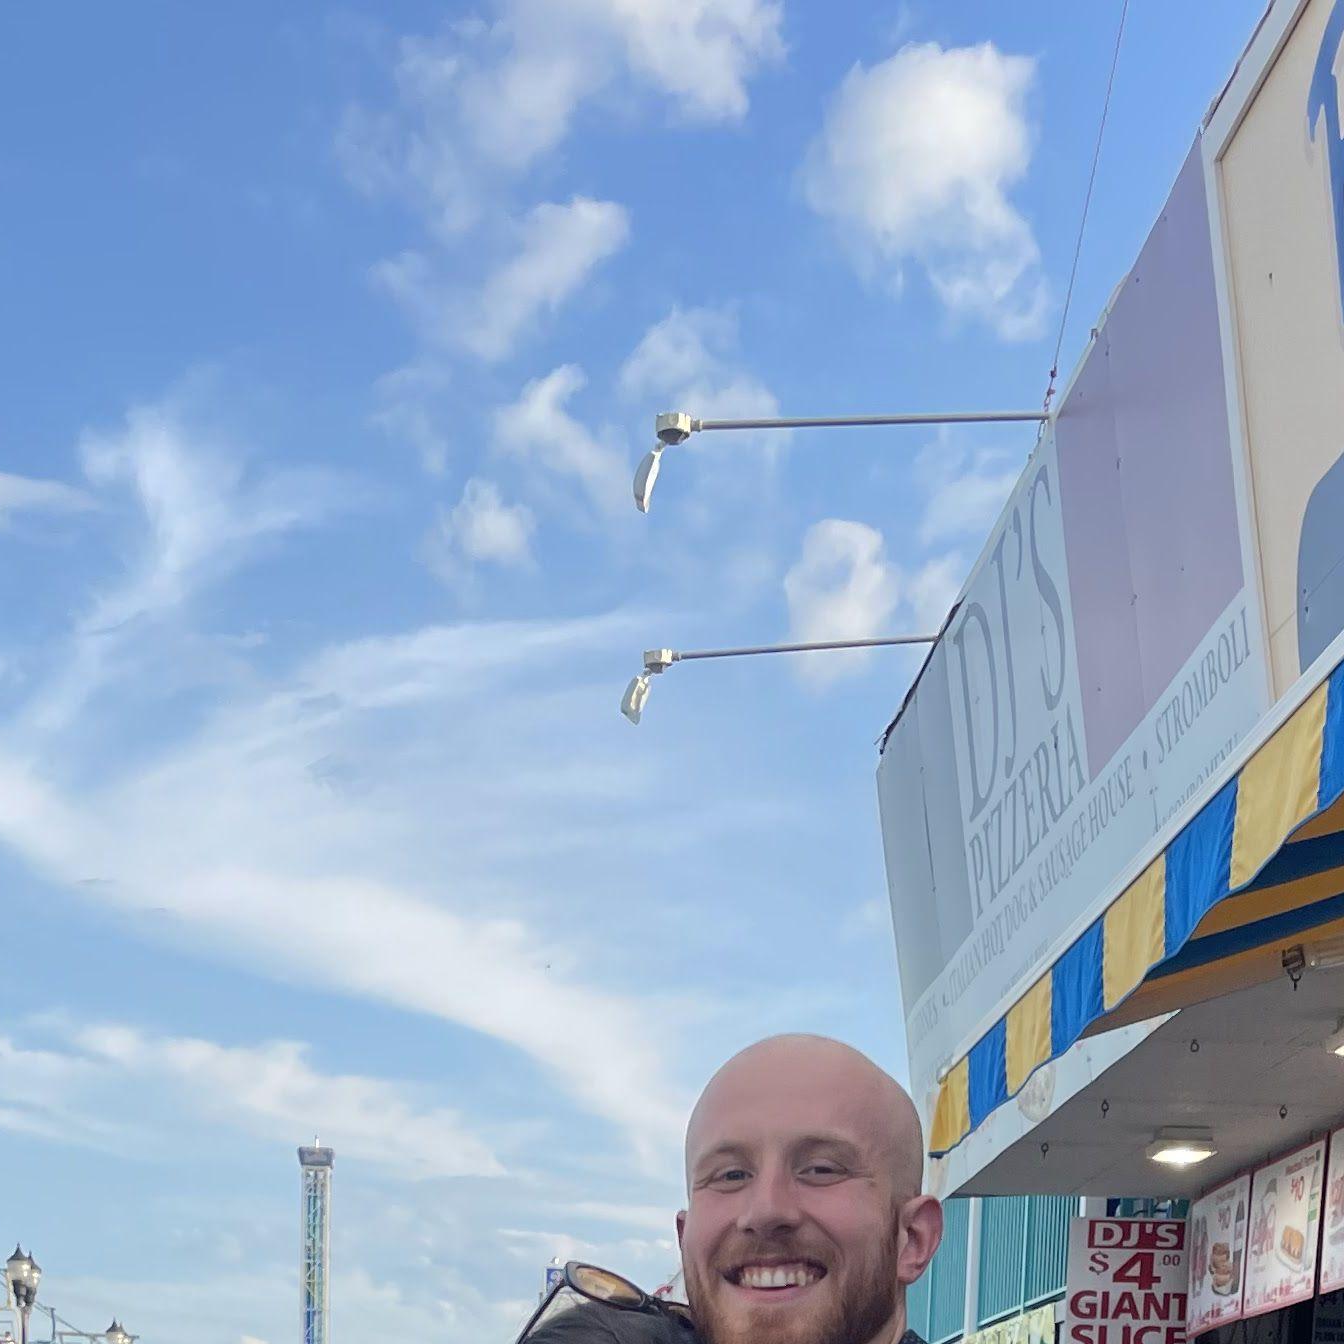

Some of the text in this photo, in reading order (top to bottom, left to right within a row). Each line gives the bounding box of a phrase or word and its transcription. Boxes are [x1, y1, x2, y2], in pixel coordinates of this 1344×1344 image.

[956, 464, 1067, 824] DJ'S
[967, 702, 1090, 920] PIZZERIA
[982, 911, 1007, 965] HOT
[1004, 893, 1030, 941] DOG
[1037, 826, 1089, 902] SAUSAGE
[1088, 753, 1136, 842] HOUSE
[1155, 605, 1251, 766] STROMBOLI
[1069, 1289, 1189, 1322] GIANT
[1093, 1221, 1179, 1248] DJ'S
